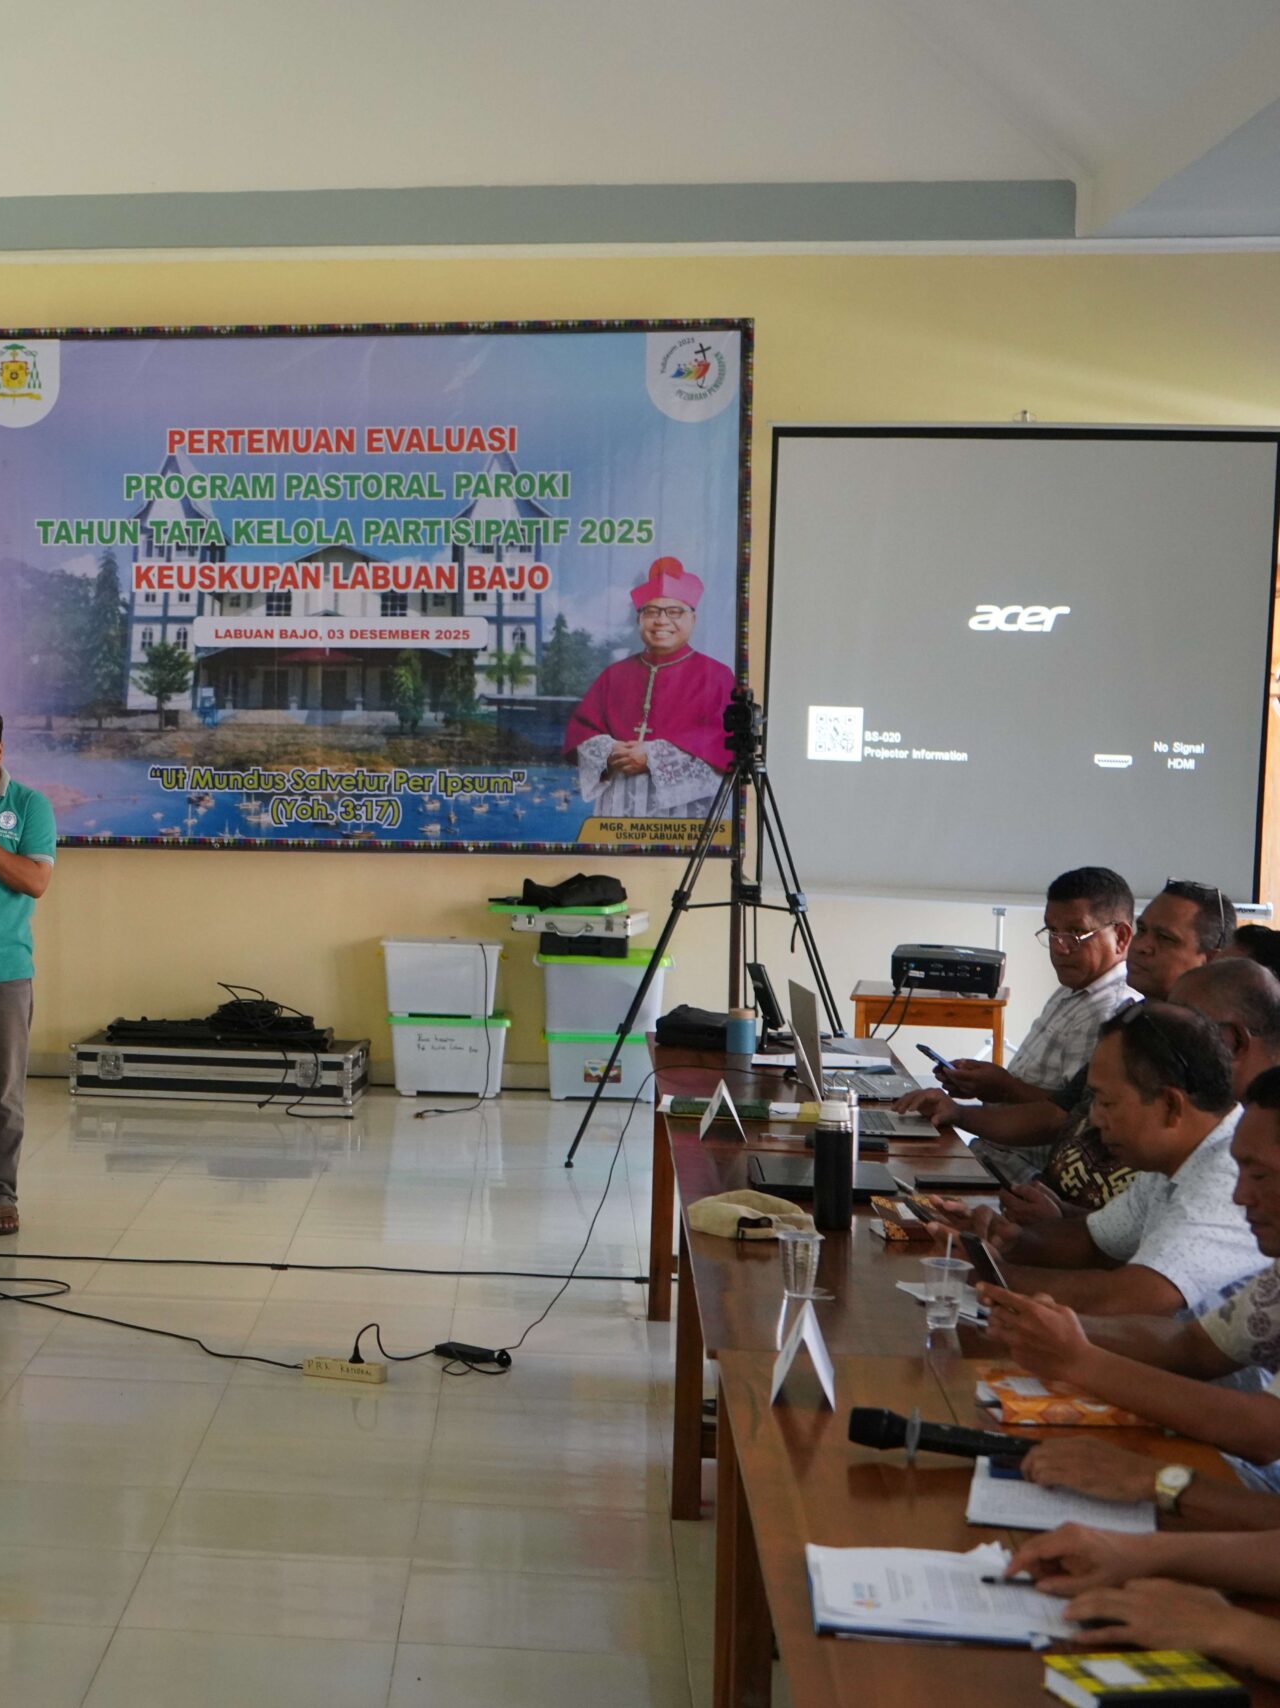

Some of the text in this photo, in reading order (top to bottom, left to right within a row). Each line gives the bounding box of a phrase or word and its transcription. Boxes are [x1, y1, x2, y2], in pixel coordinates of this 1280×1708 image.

[168, 426, 517, 454] PERTEMUAN EVALUASI
[124, 472, 570, 499] PROGRAM PASTORAL PAROKI
[36, 518, 655, 545] TAHUN TATA KELOLA PARTISIPATIF 2025
[133, 564, 550, 591] KEUSKUPAN LABUAN BAJO
[968, 604, 1071, 632] acer
[214, 629, 470, 641] LABUAN BAJO, 03 DESEMBER 2025
[864, 731, 901, 743] BS-020
[864, 746, 968, 761] Projector Information
[1153, 741, 1205, 755] No Signal
[1167, 758, 1195, 770] HDMI
[191, 767, 287, 792] Mundus
[291, 768, 388, 793] Salvetur
[394, 770, 434, 793] Per
[271, 798, 402, 828] (Yoh. 3:17)
[600, 822, 627, 831] MGR.
[630, 823, 687, 832] MAKSIMUS
[649, 832, 684, 840] LABUAN
